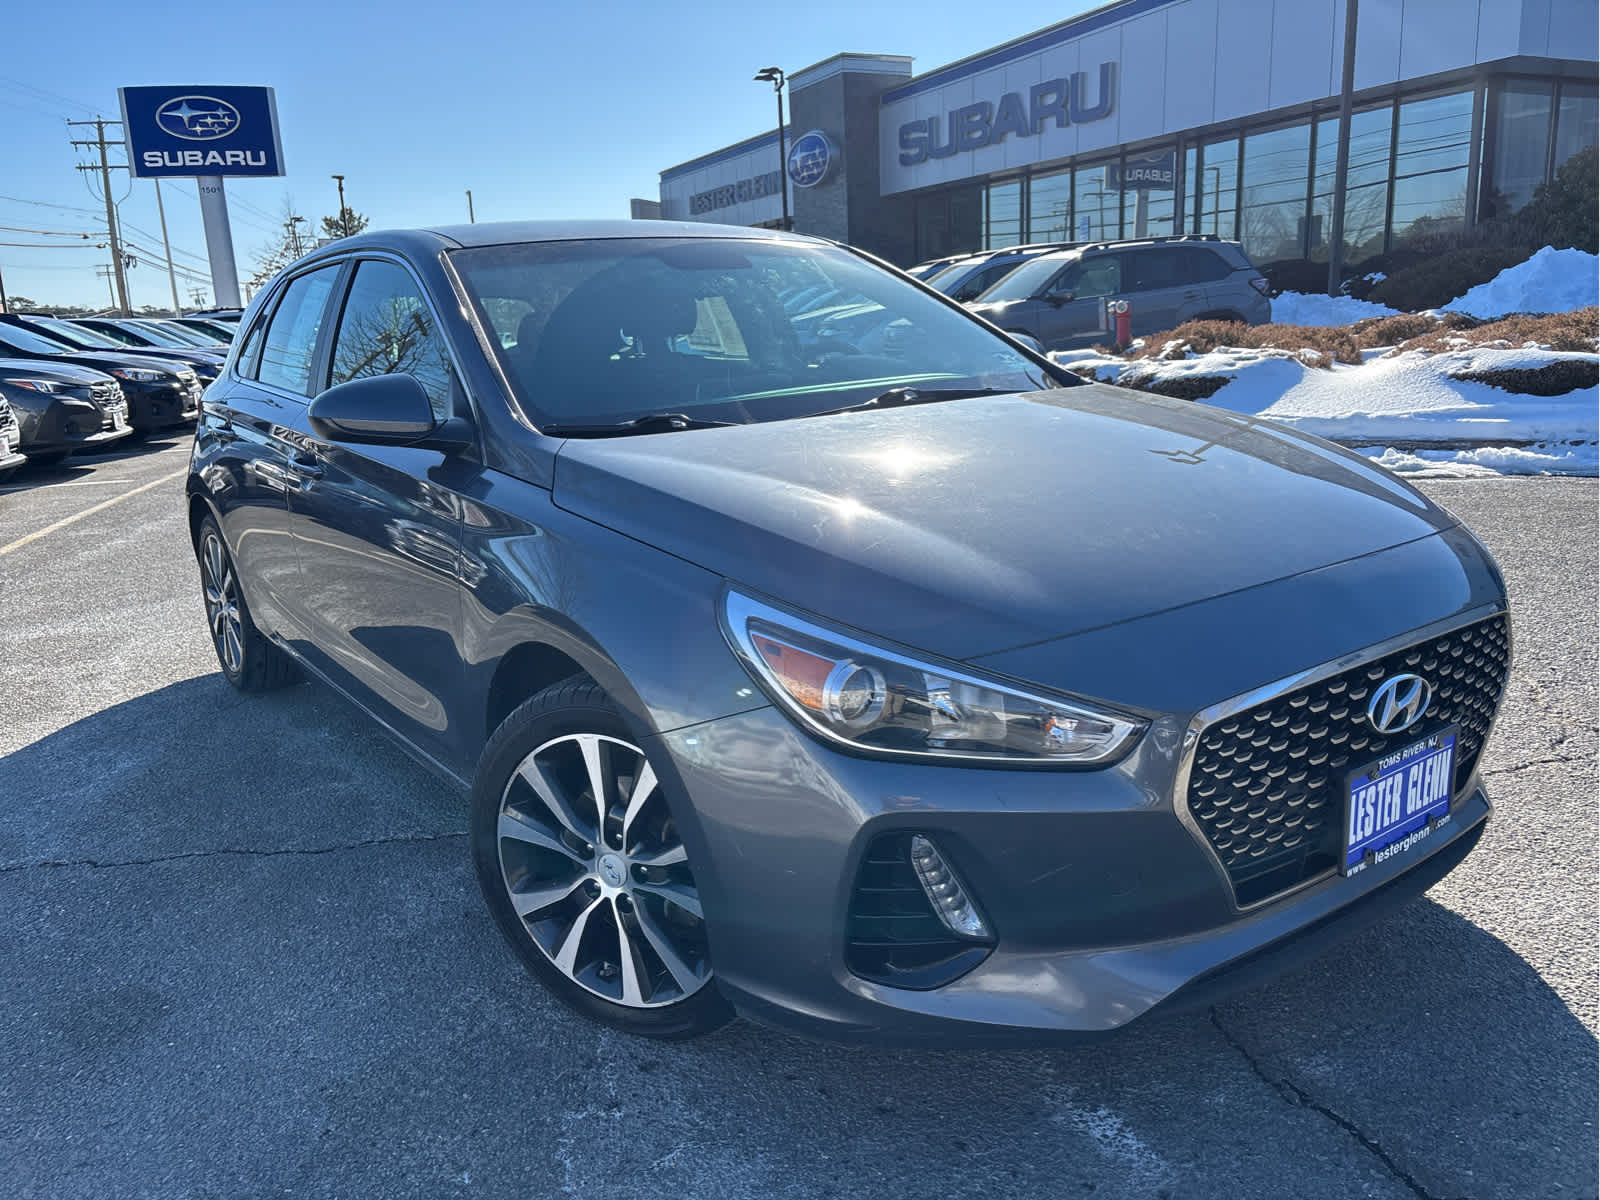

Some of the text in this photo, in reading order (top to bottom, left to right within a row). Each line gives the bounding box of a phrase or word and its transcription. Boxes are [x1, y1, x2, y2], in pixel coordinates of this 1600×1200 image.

[898, 61, 1116, 167] SUBARU
[143, 150, 266, 167] SUBARU
[689, 184, 736, 215] LESTER
[1378, 756, 1401, 771] TOMS
[1349, 748, 1452, 846] LESTER GLENN
